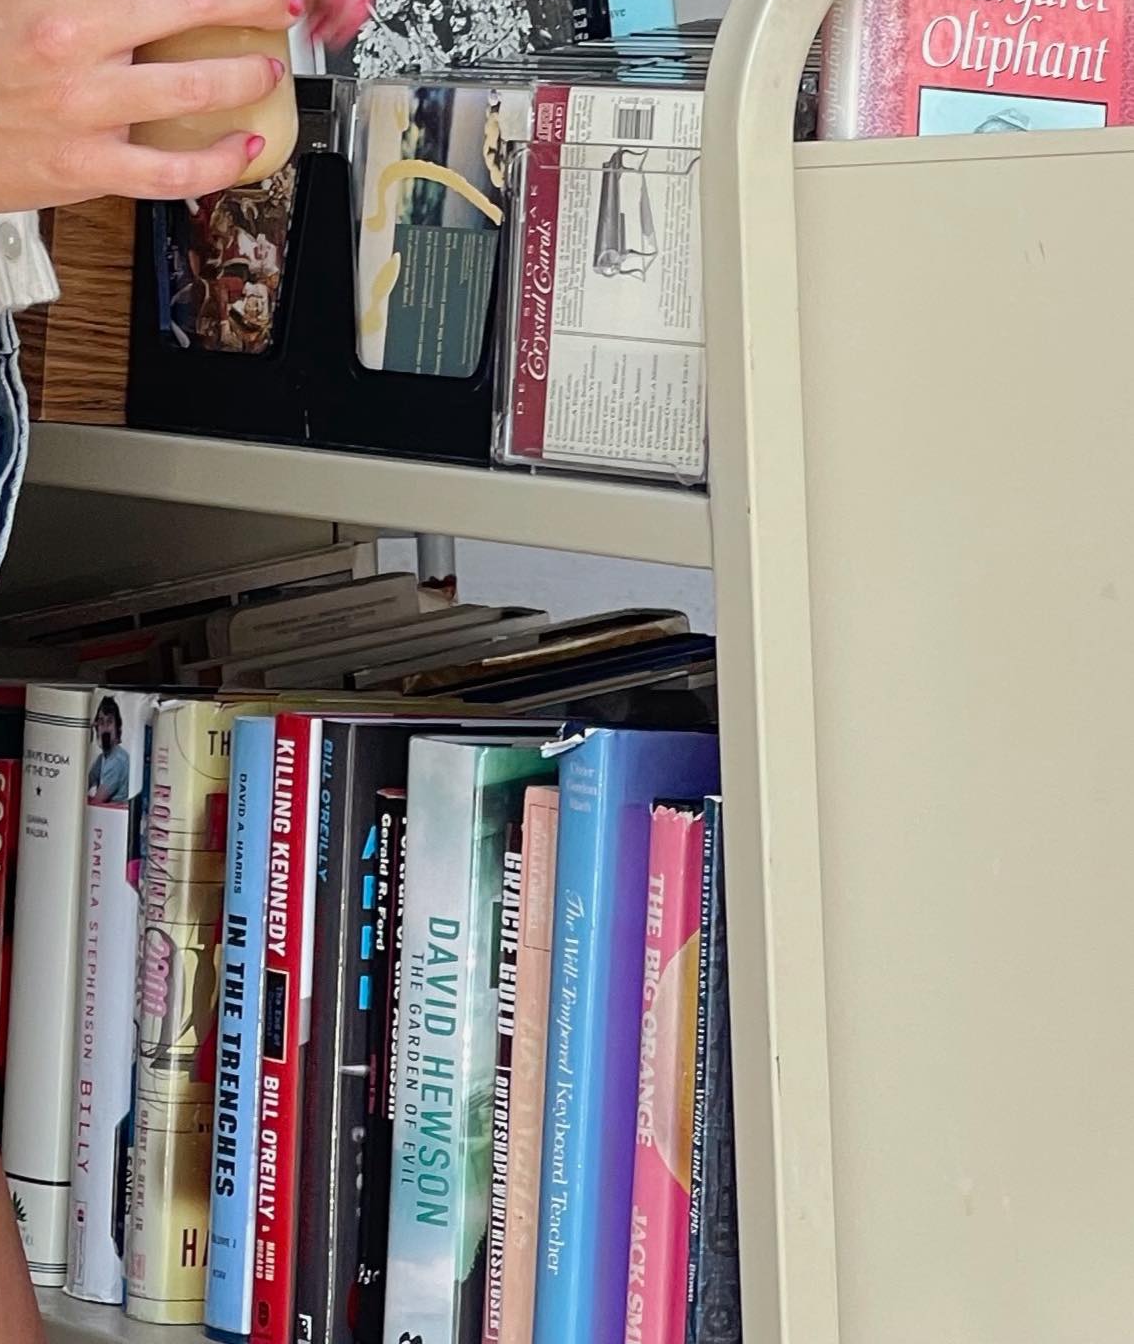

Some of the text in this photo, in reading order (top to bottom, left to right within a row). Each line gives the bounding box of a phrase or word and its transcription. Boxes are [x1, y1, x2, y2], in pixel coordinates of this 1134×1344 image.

[921, 9, 1111, 88] Oliphant
[554, 105, 563, 141] ADD
[526, 218, 553, 381] Crystal Carols
[516, 338, 529, 415] DEAN
[208, 730, 231, 756] TH
[317, 738, 334, 883] BILL O'REILLY
[233, 772, 248, 895] DAVID A HARRIS
[267, 738, 296, 958] KILLING KENNEDY
[375, 813, 391, 952] Gerald R. Ford
[77, 827, 104, 1175] PAMELA STEPHENSON BILLY
[496, 851, 523, 1037] GRACIE GOLD
[636, 872, 665, 1148] THE BIG ORANGE
[215, 913, 248, 1198] IN THE TRENCHES
[262, 1074, 280, 1121] BILL
[400, 952, 425, 1186] THE GARDEN OF EVIL
[415, 916, 461, 1228] DAVID HEWSON
[546, 887, 585, 1277] The Well-Tempered Keyboard Teacher
[688, 828, 712, 1236] THE BRITISH LIBRARY GUIDE TO Writing and Scripts
[257, 1130, 280, 1221] O'REILLY
[628, 1204, 648, 1288] JACK
[265, 1241, 276, 1282] MARTIN
